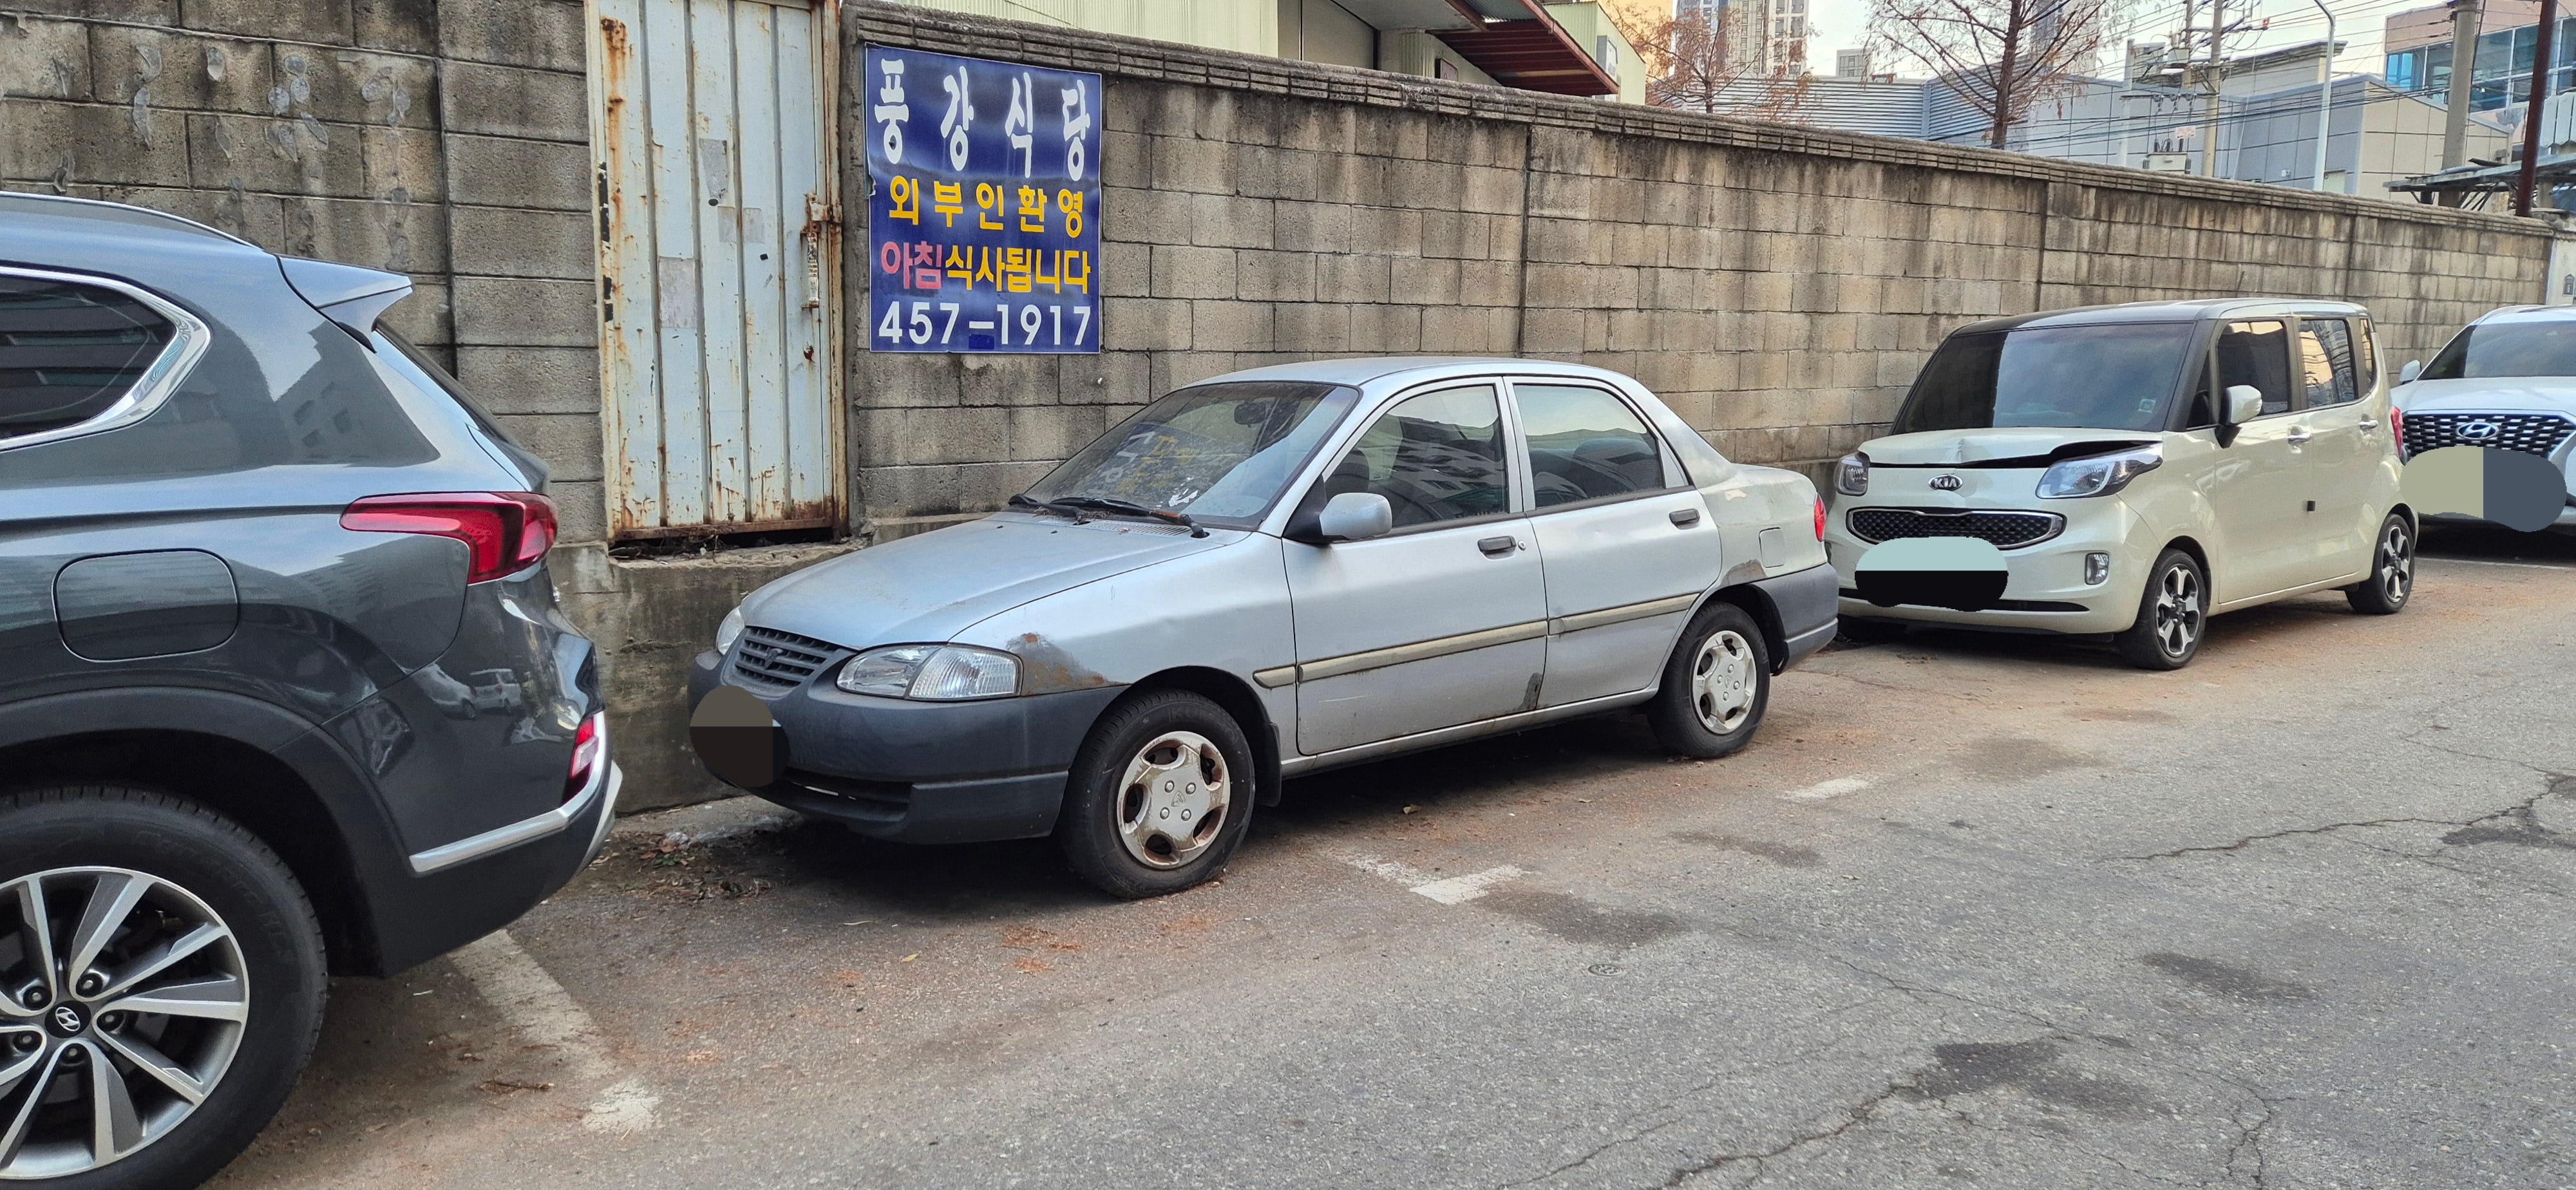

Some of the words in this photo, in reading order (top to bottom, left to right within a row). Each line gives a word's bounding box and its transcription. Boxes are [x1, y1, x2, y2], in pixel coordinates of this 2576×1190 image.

[874, 58, 1091, 182] 풍강식당
[878, 301, 1091, 346] 457-1917
[1934, 478, 1957, 488] KIA
